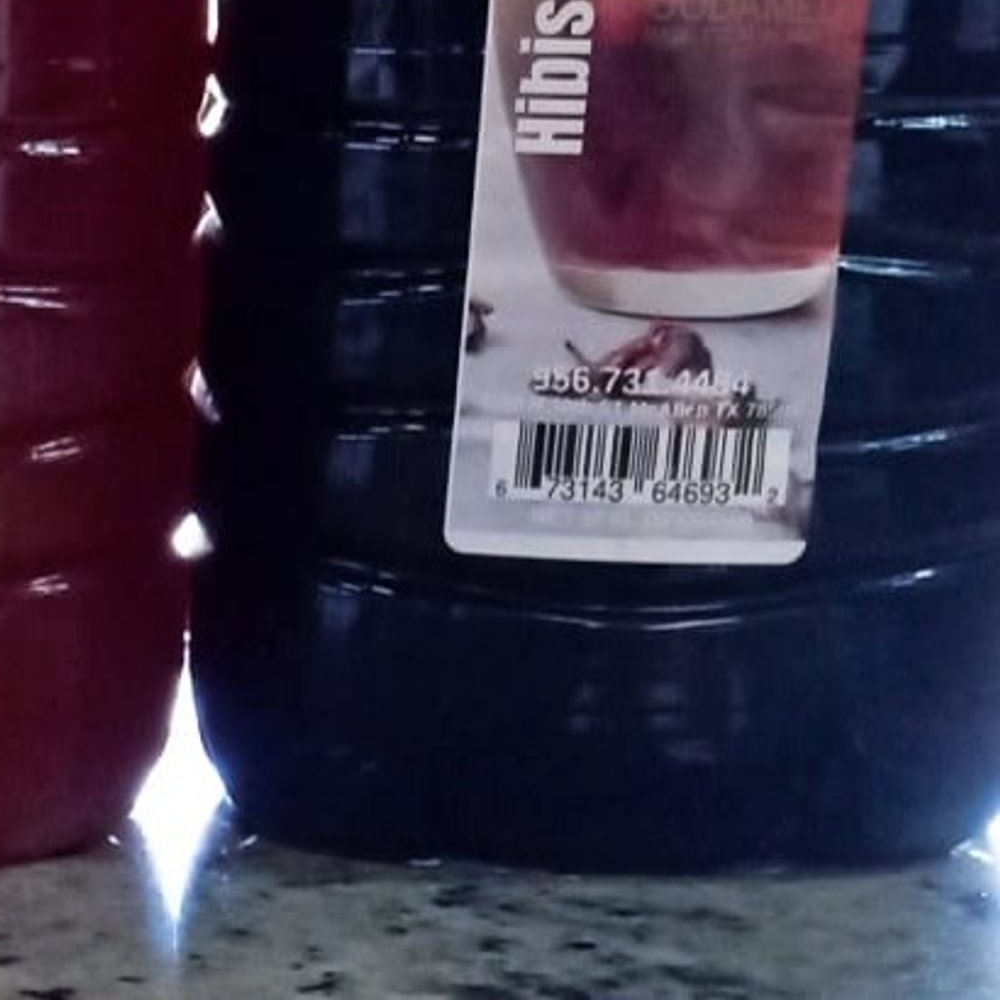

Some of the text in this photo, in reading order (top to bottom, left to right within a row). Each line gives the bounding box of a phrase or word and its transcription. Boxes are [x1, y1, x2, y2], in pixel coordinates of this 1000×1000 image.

[495, 479, 508, 498] 6
[547, 479, 625, 503] 73143
[651, 481, 731, 504] 64693
